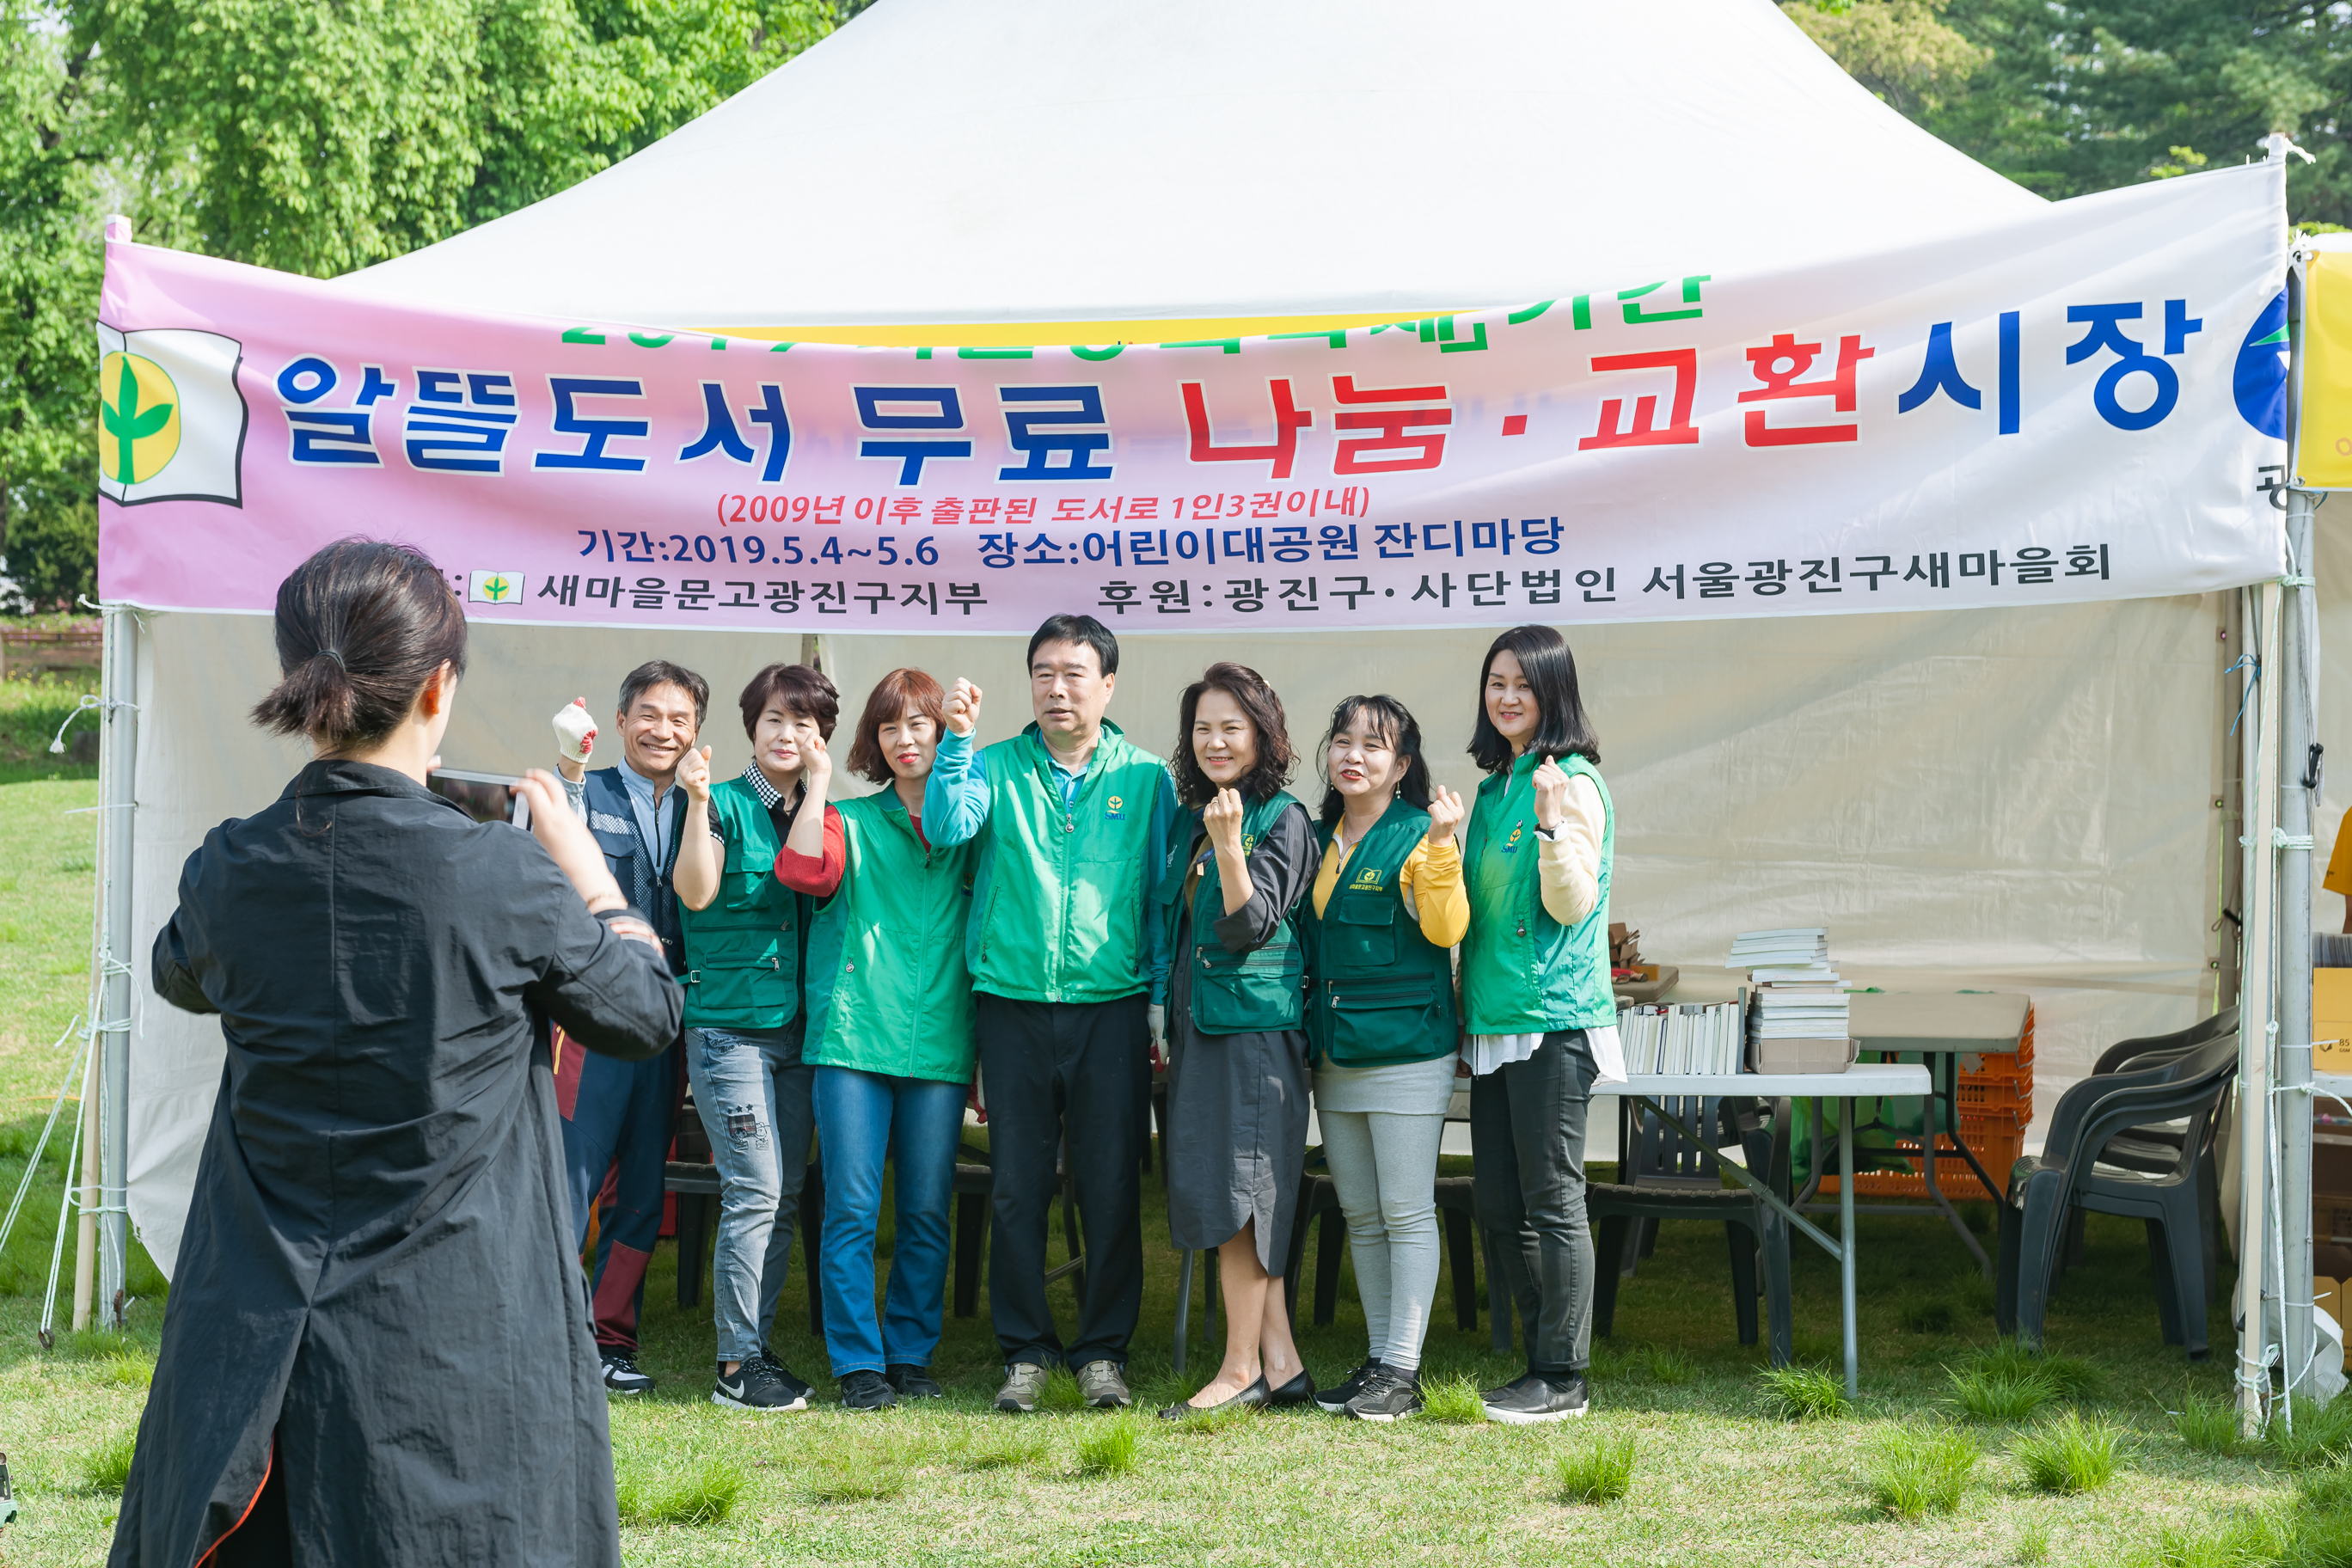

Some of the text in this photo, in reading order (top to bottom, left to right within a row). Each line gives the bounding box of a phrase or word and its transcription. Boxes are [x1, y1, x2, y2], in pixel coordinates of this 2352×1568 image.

[276, 357, 792, 484] 알뜰도서
[853, 385, 1115, 487] 무료
[1179, 374, 1453, 481] 나눔
[717, 493, 847, 526] (2009년
[854, 496, 924, 527] 이후
[931, 496, 1038, 526] 출판된
[1051, 496, 1160, 524] 도서로
[1373, 517, 1565, 560] 잔디마당
[537, 574, 989, 617] 새마을문고광진구지부
[1642, 543, 2110, 600] 서울광진구새마을회
[1105, 812, 1126, 821] SMU
[2338, 1038, 2350, 1047] 85
